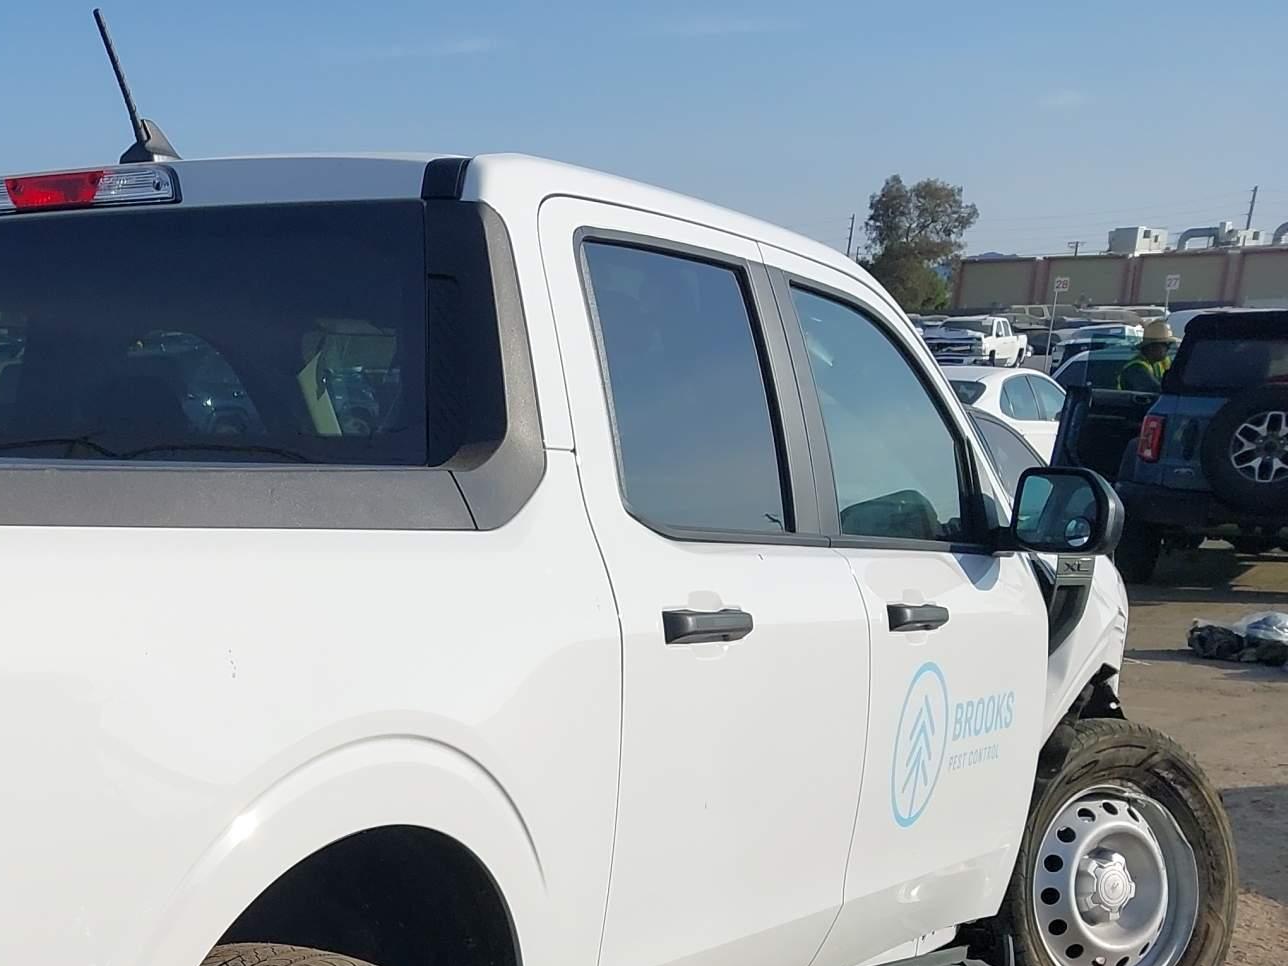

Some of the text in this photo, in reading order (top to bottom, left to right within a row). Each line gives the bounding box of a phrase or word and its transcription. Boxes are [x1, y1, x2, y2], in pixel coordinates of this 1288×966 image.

[1055, 279, 1068, 289] 28
[1064, 560, 1089, 572] XL
[952, 691, 1015, 741] BROOKS
[948, 744, 999, 772] PEST CONTROL
